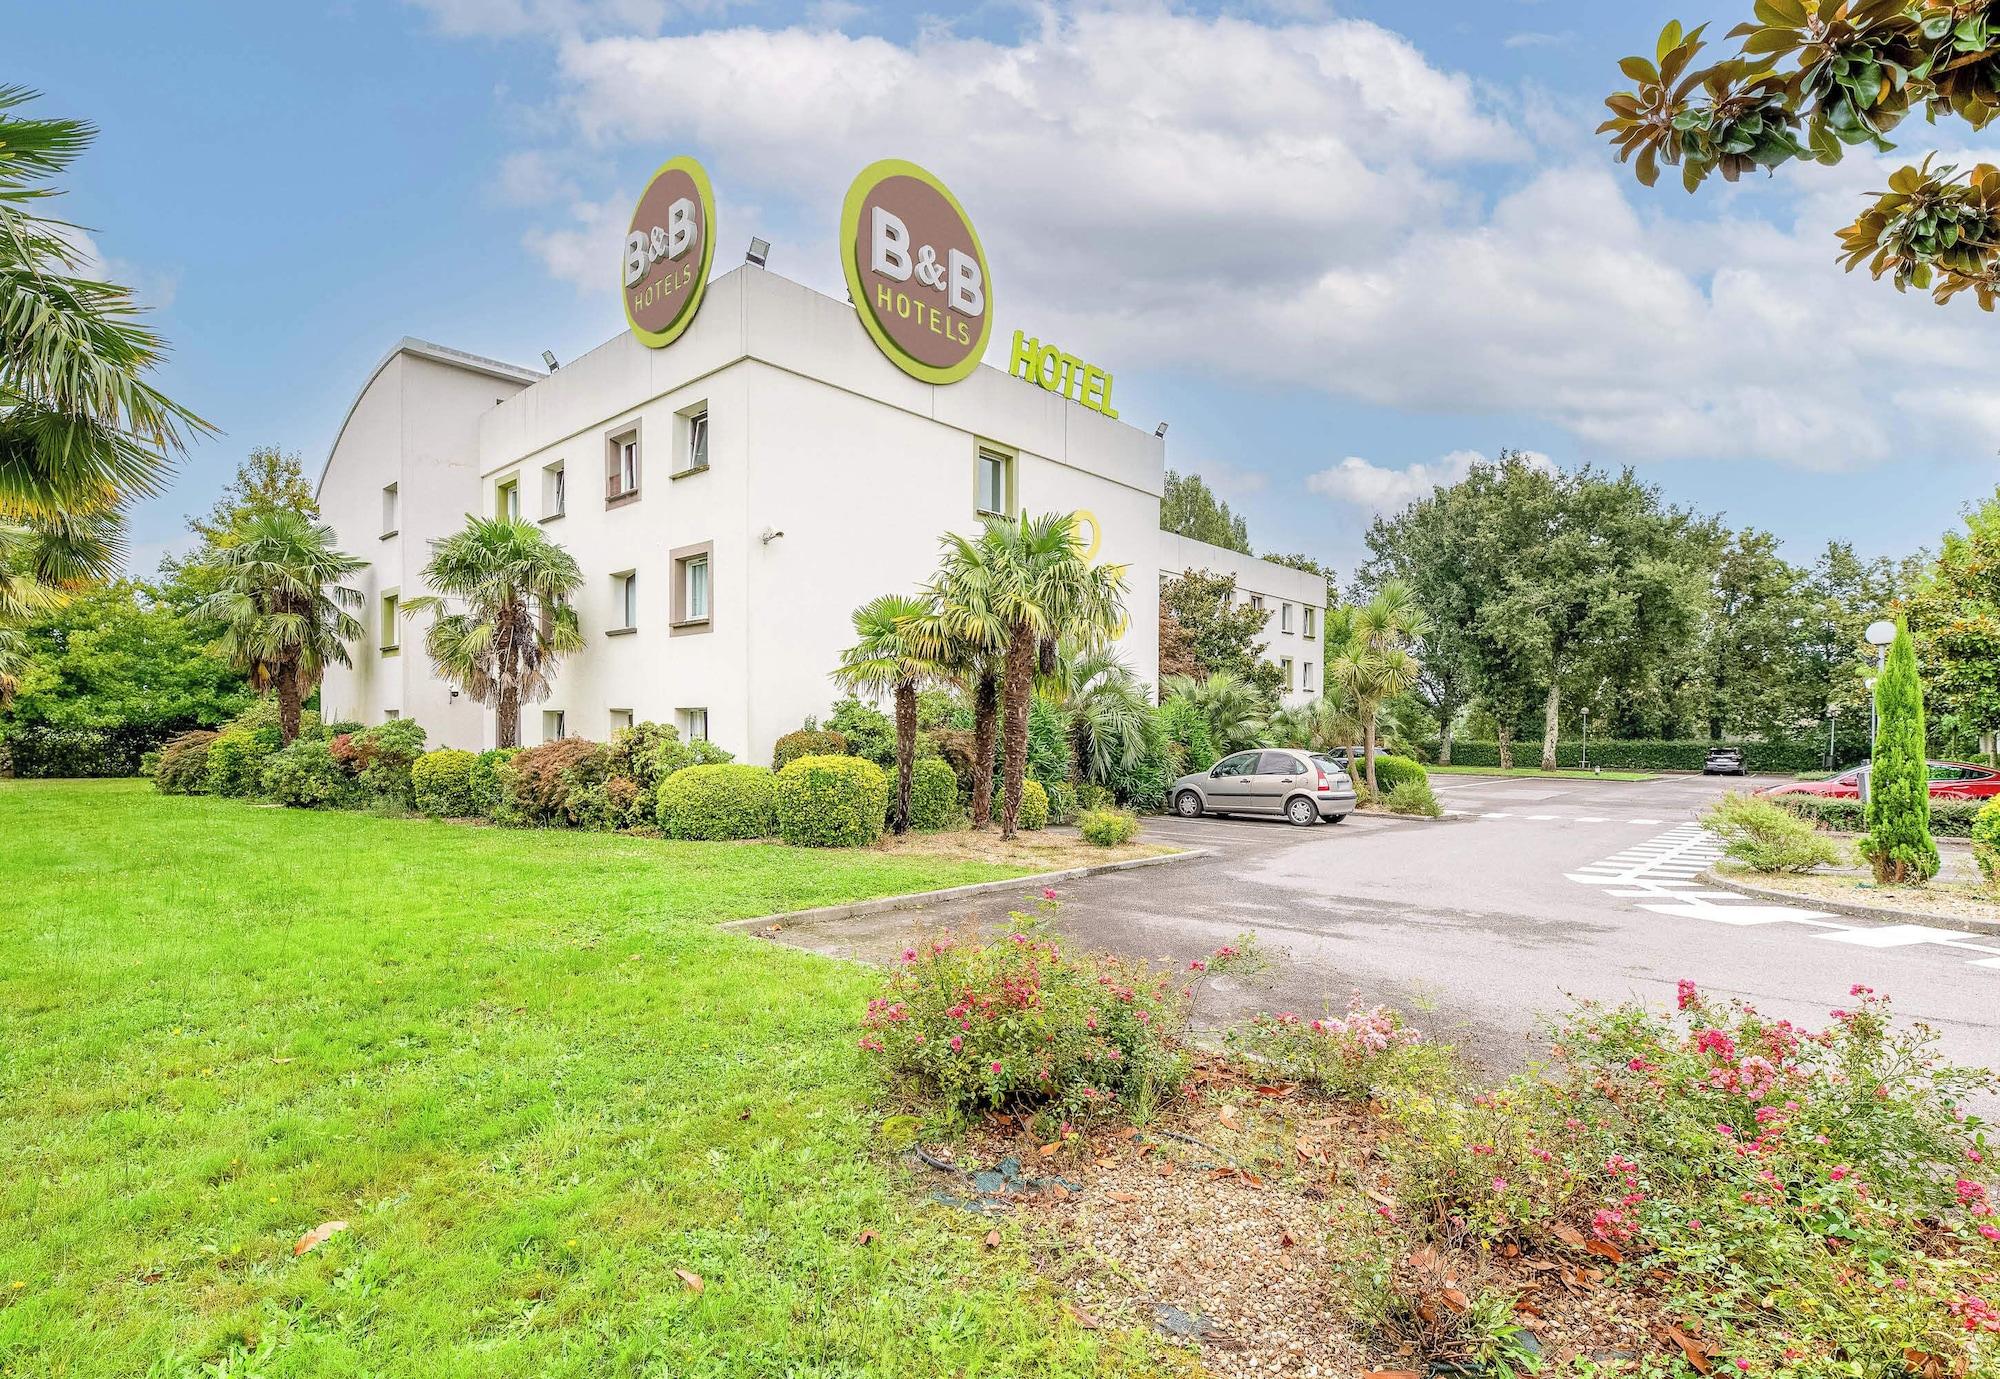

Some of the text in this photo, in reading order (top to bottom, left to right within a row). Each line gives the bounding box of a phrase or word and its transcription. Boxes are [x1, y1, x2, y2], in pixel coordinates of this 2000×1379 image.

[624, 198, 697, 288] B&B
[634, 264, 691, 312] HOTELS
[871, 206, 985, 317] B&B
[877, 284, 970, 346] HOTELS
[1008, 329, 1118, 419] HOTEL
